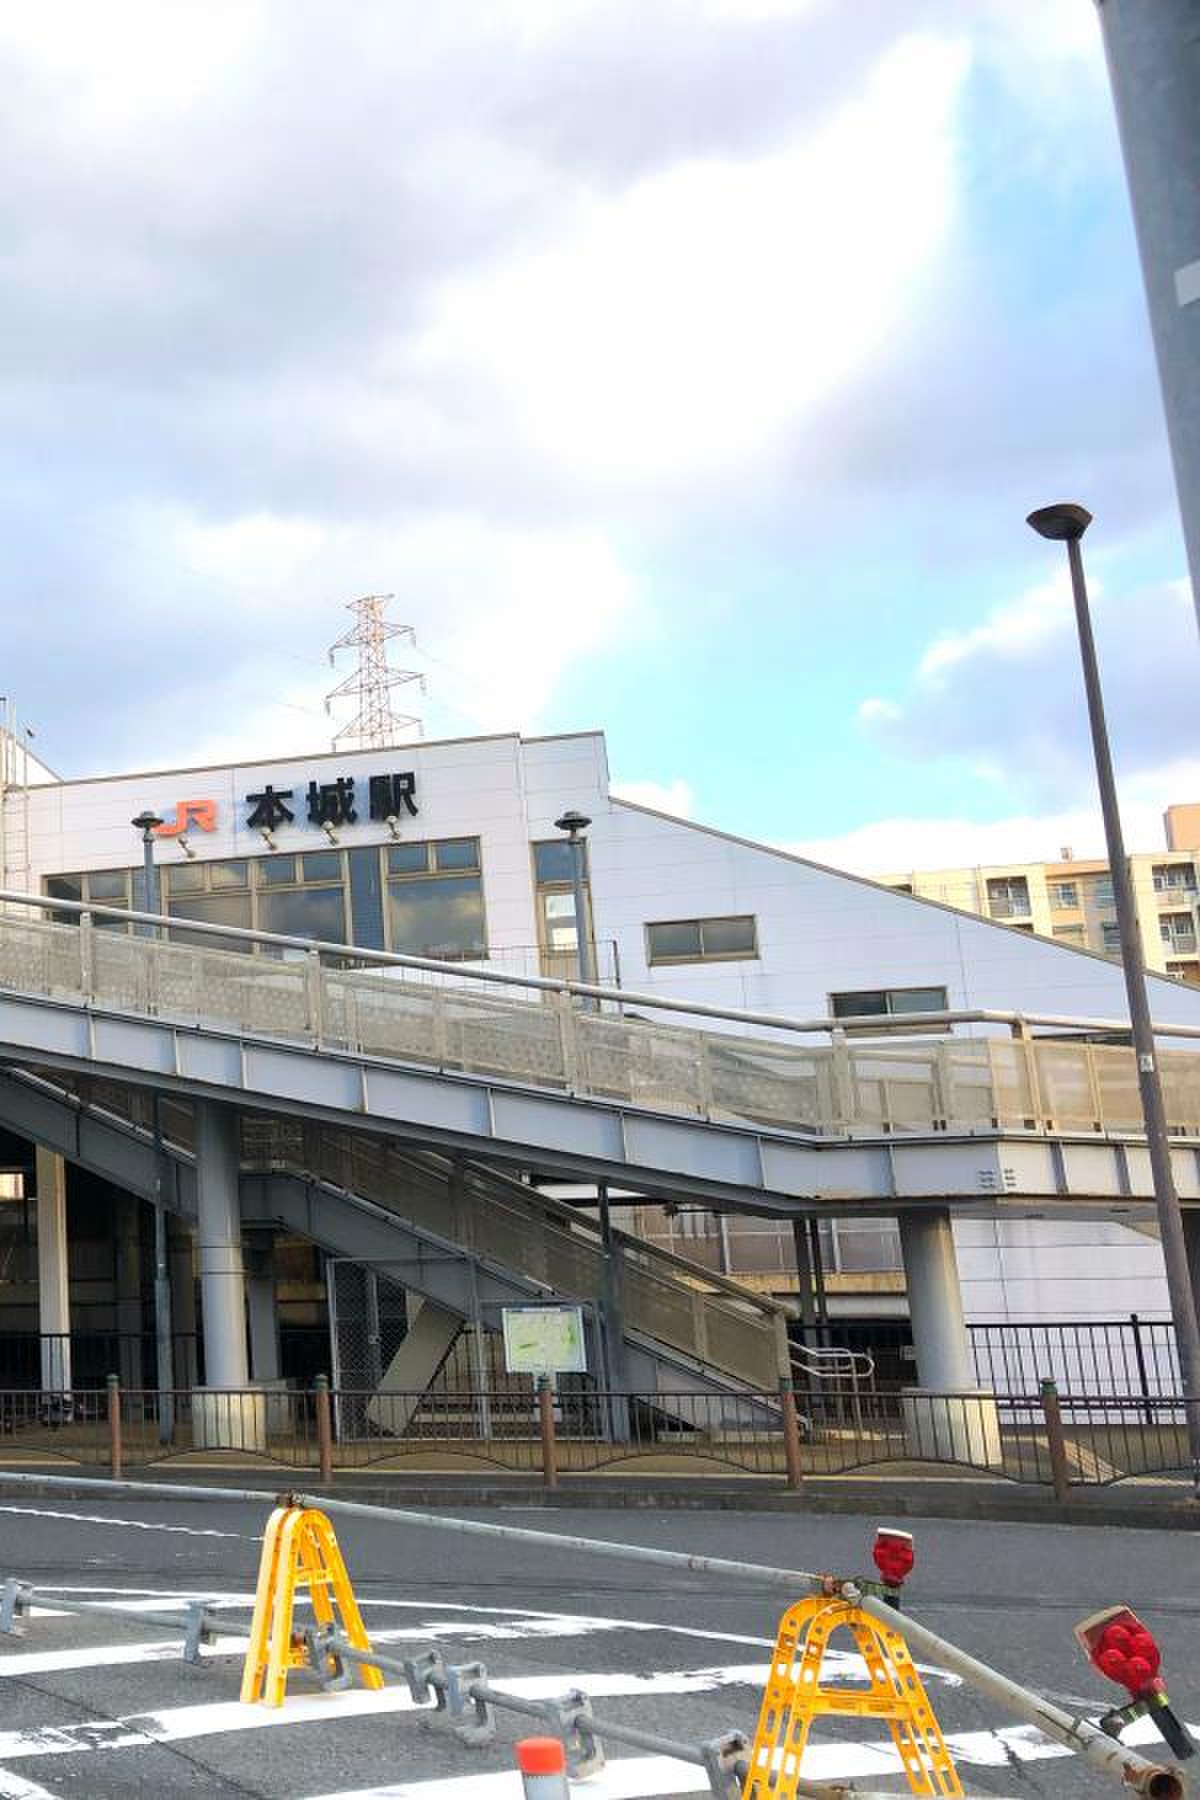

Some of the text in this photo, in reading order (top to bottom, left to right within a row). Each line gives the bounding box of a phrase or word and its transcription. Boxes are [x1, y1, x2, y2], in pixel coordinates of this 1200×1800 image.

[153, 772, 418, 837] JR 本城駅
